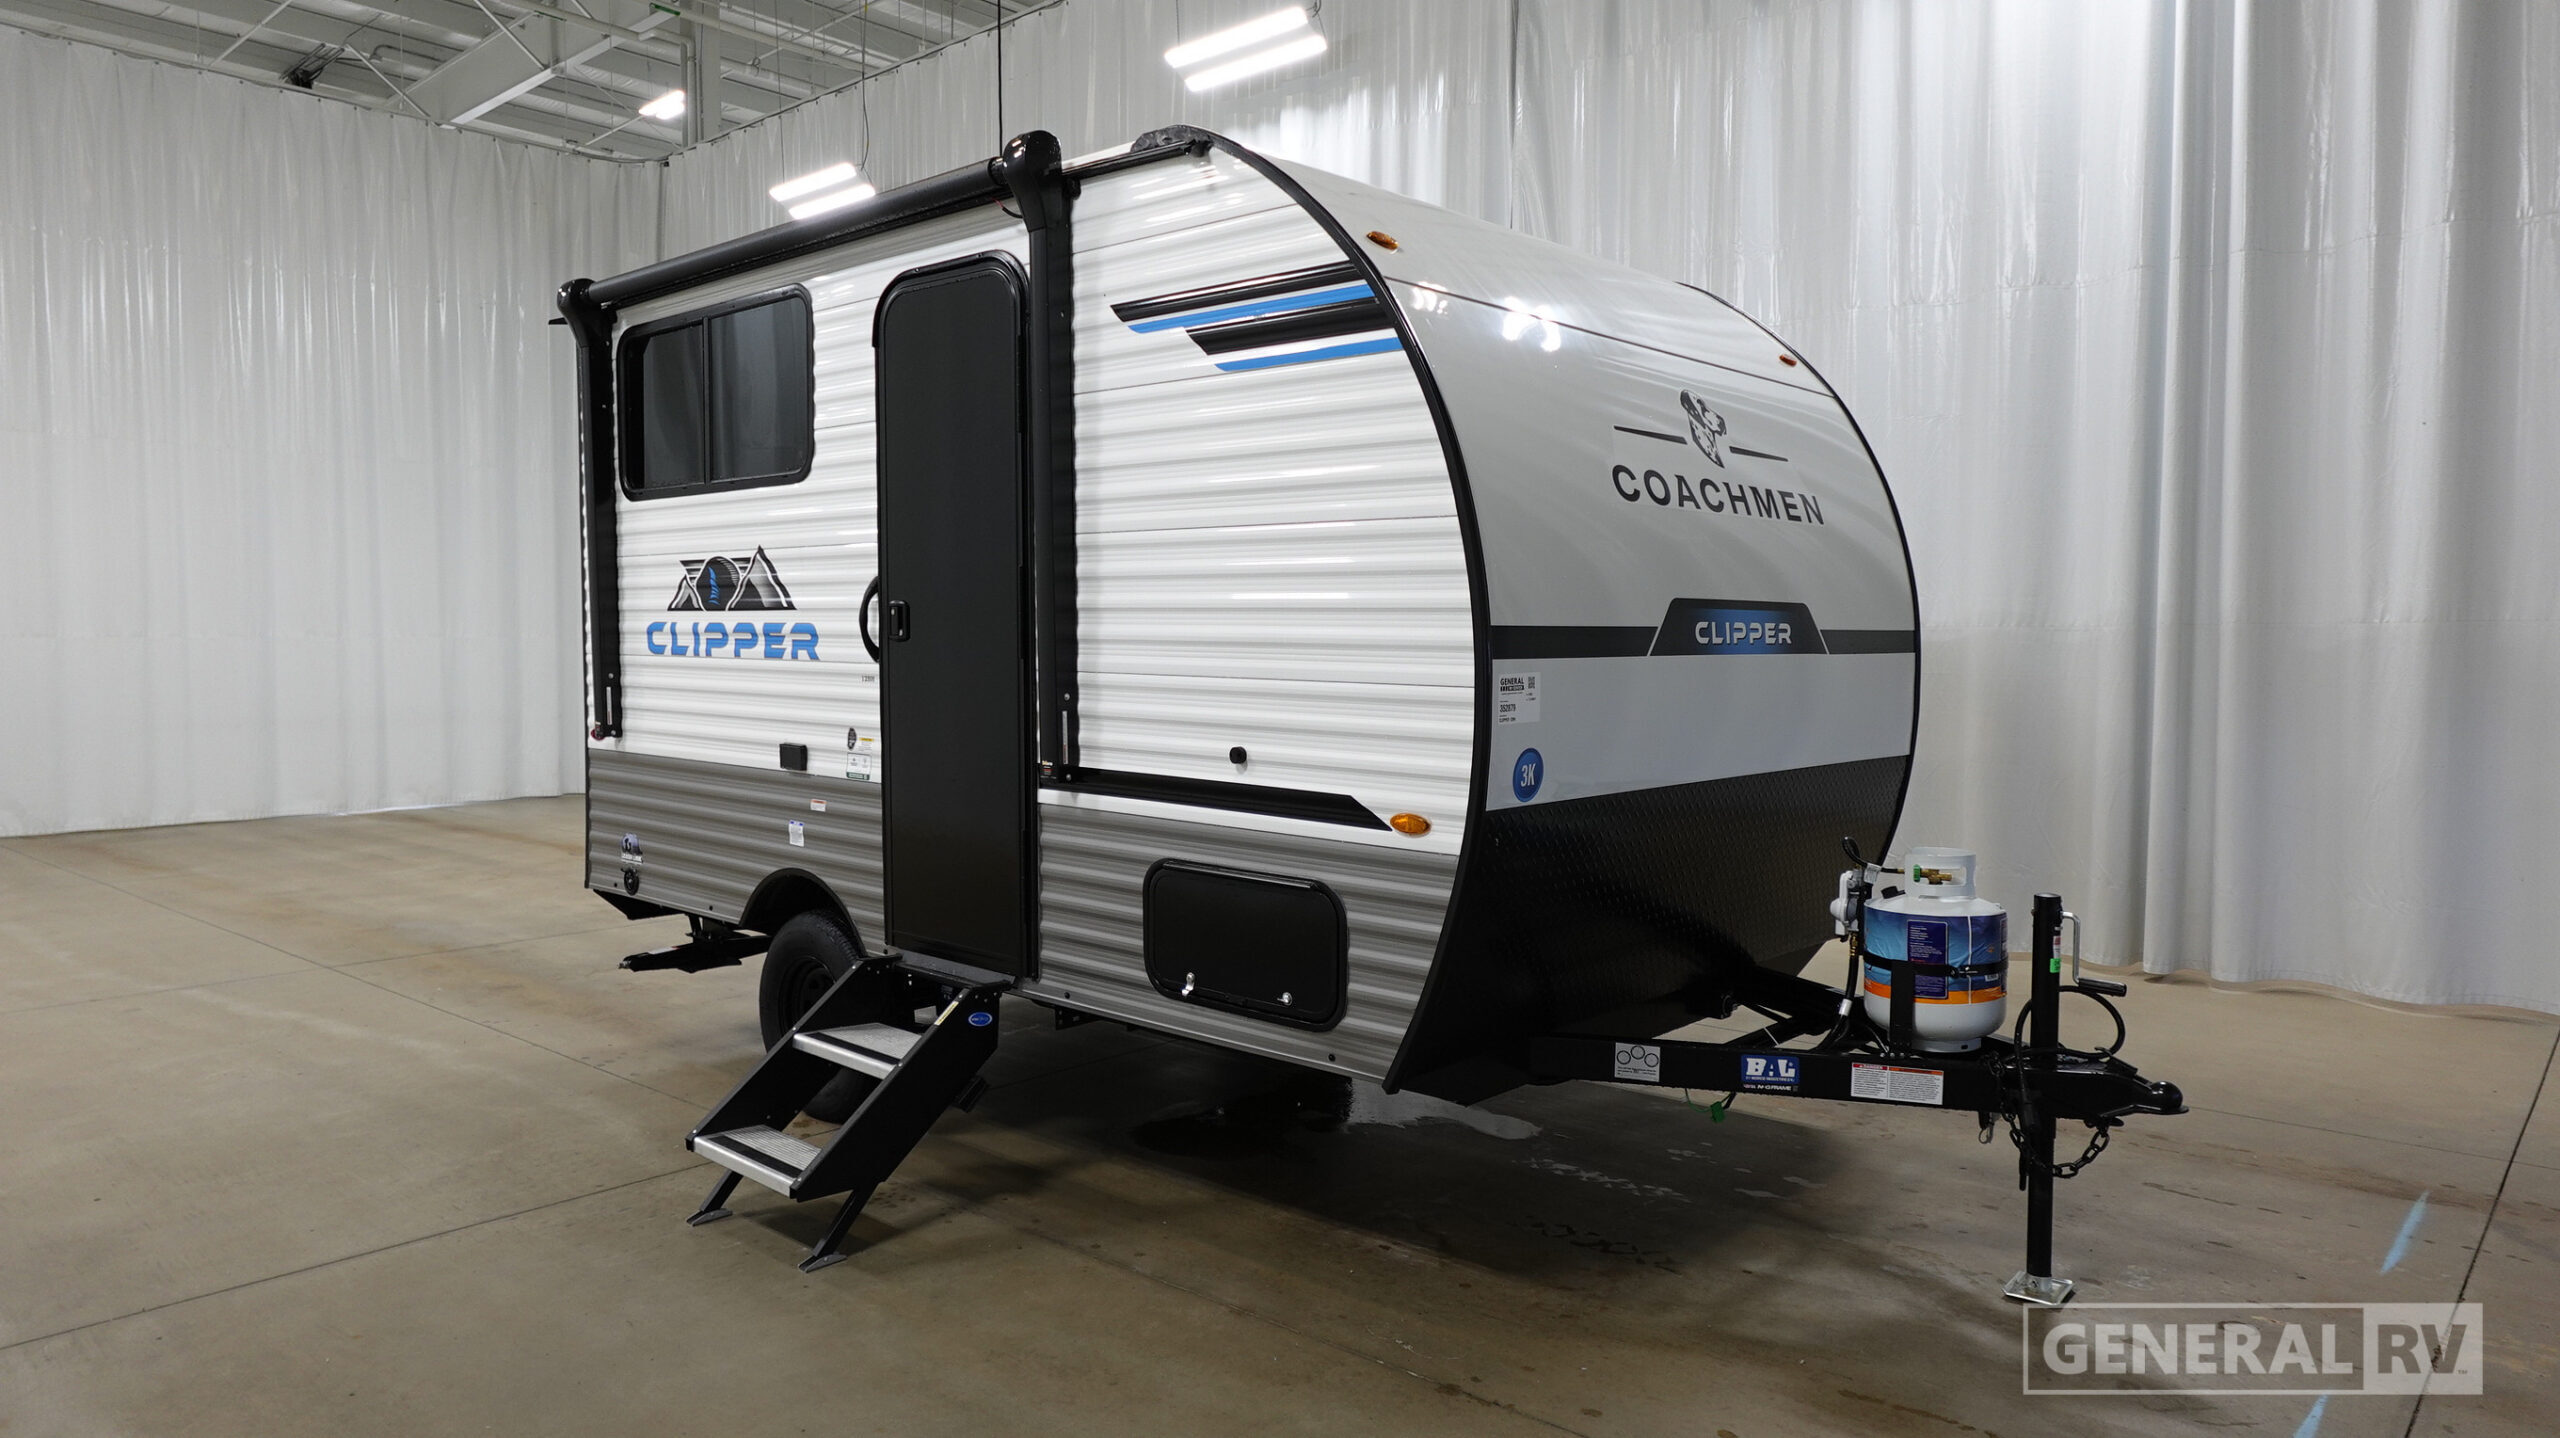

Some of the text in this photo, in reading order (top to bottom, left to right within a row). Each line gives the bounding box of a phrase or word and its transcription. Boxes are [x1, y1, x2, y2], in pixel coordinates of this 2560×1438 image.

[1612, 464, 1825, 525] COACHMEN
[646, 621, 821, 661] CLIPPER
[1694, 621, 1792, 645] CLIPPER
[1500, 677, 1524, 686] GENERAL
[1520, 763, 1536, 787] 3K
[1746, 1058, 1796, 1077] BAL
